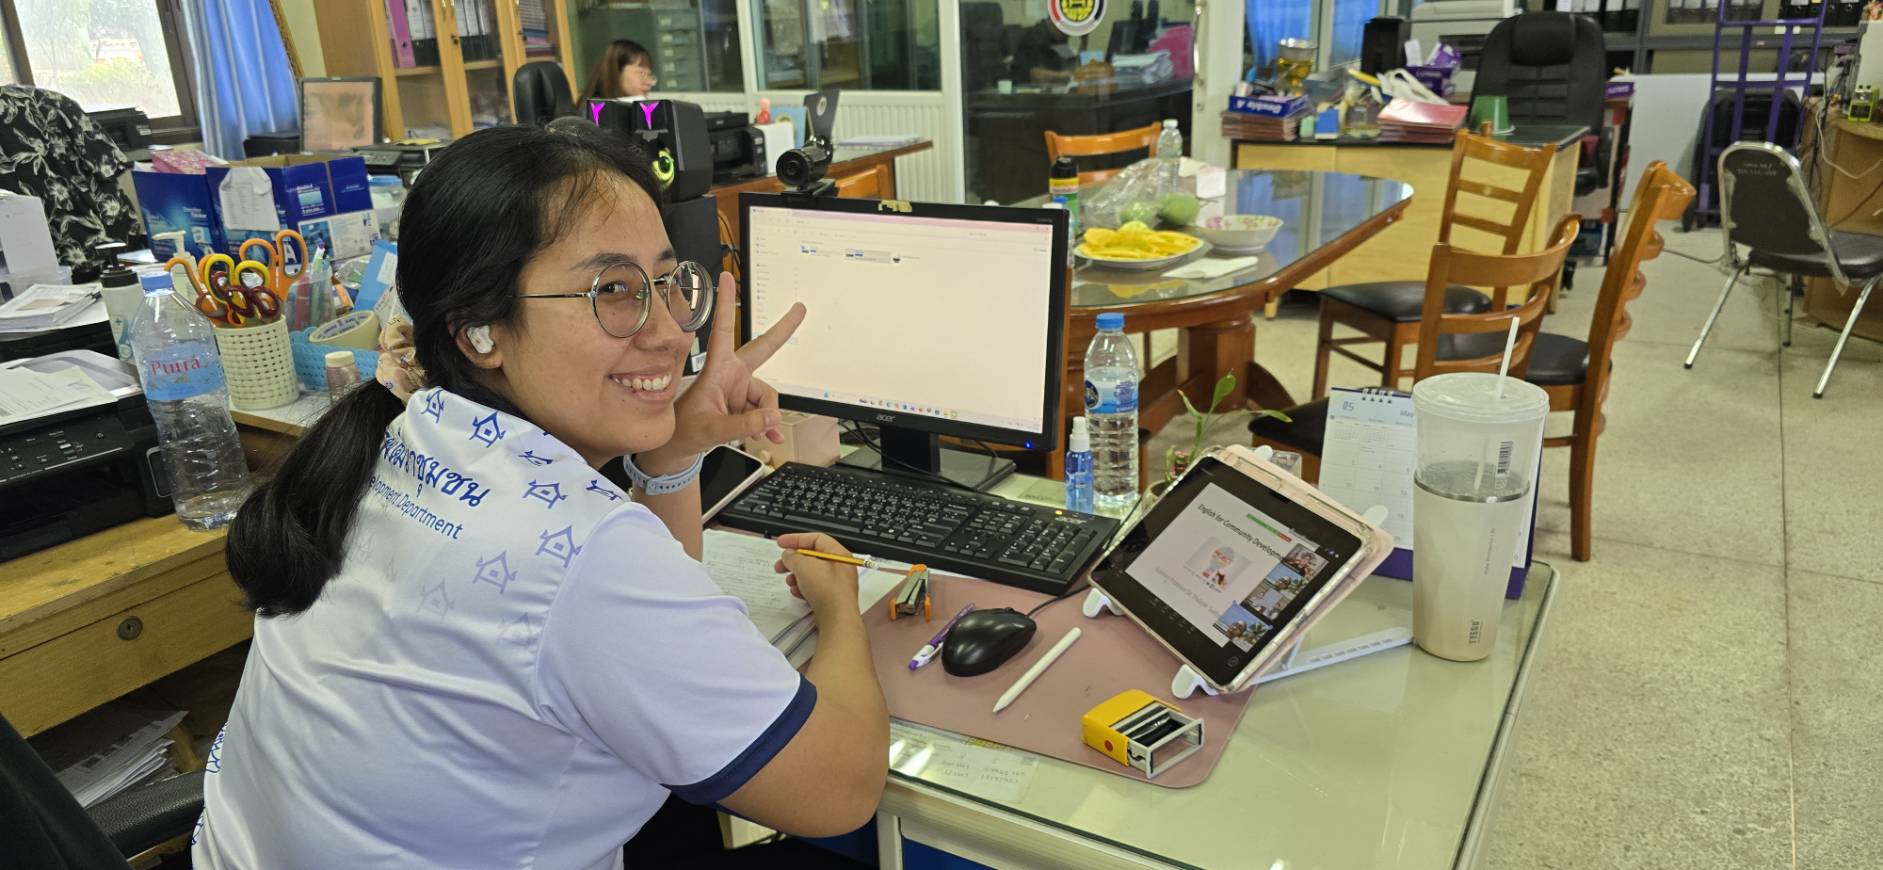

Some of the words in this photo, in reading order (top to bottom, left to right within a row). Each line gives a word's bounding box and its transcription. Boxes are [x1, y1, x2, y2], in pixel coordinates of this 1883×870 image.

[1342, 401, 1355, 412] 05
[876, 413, 897, 423] acer
[397, 493, 463, 540] Department
[1055, 516, 1087, 525] acer
[1198, 503, 1216, 518] English
[1215, 514, 1225, 522] for
[1223, 519, 1253, 542] Community
